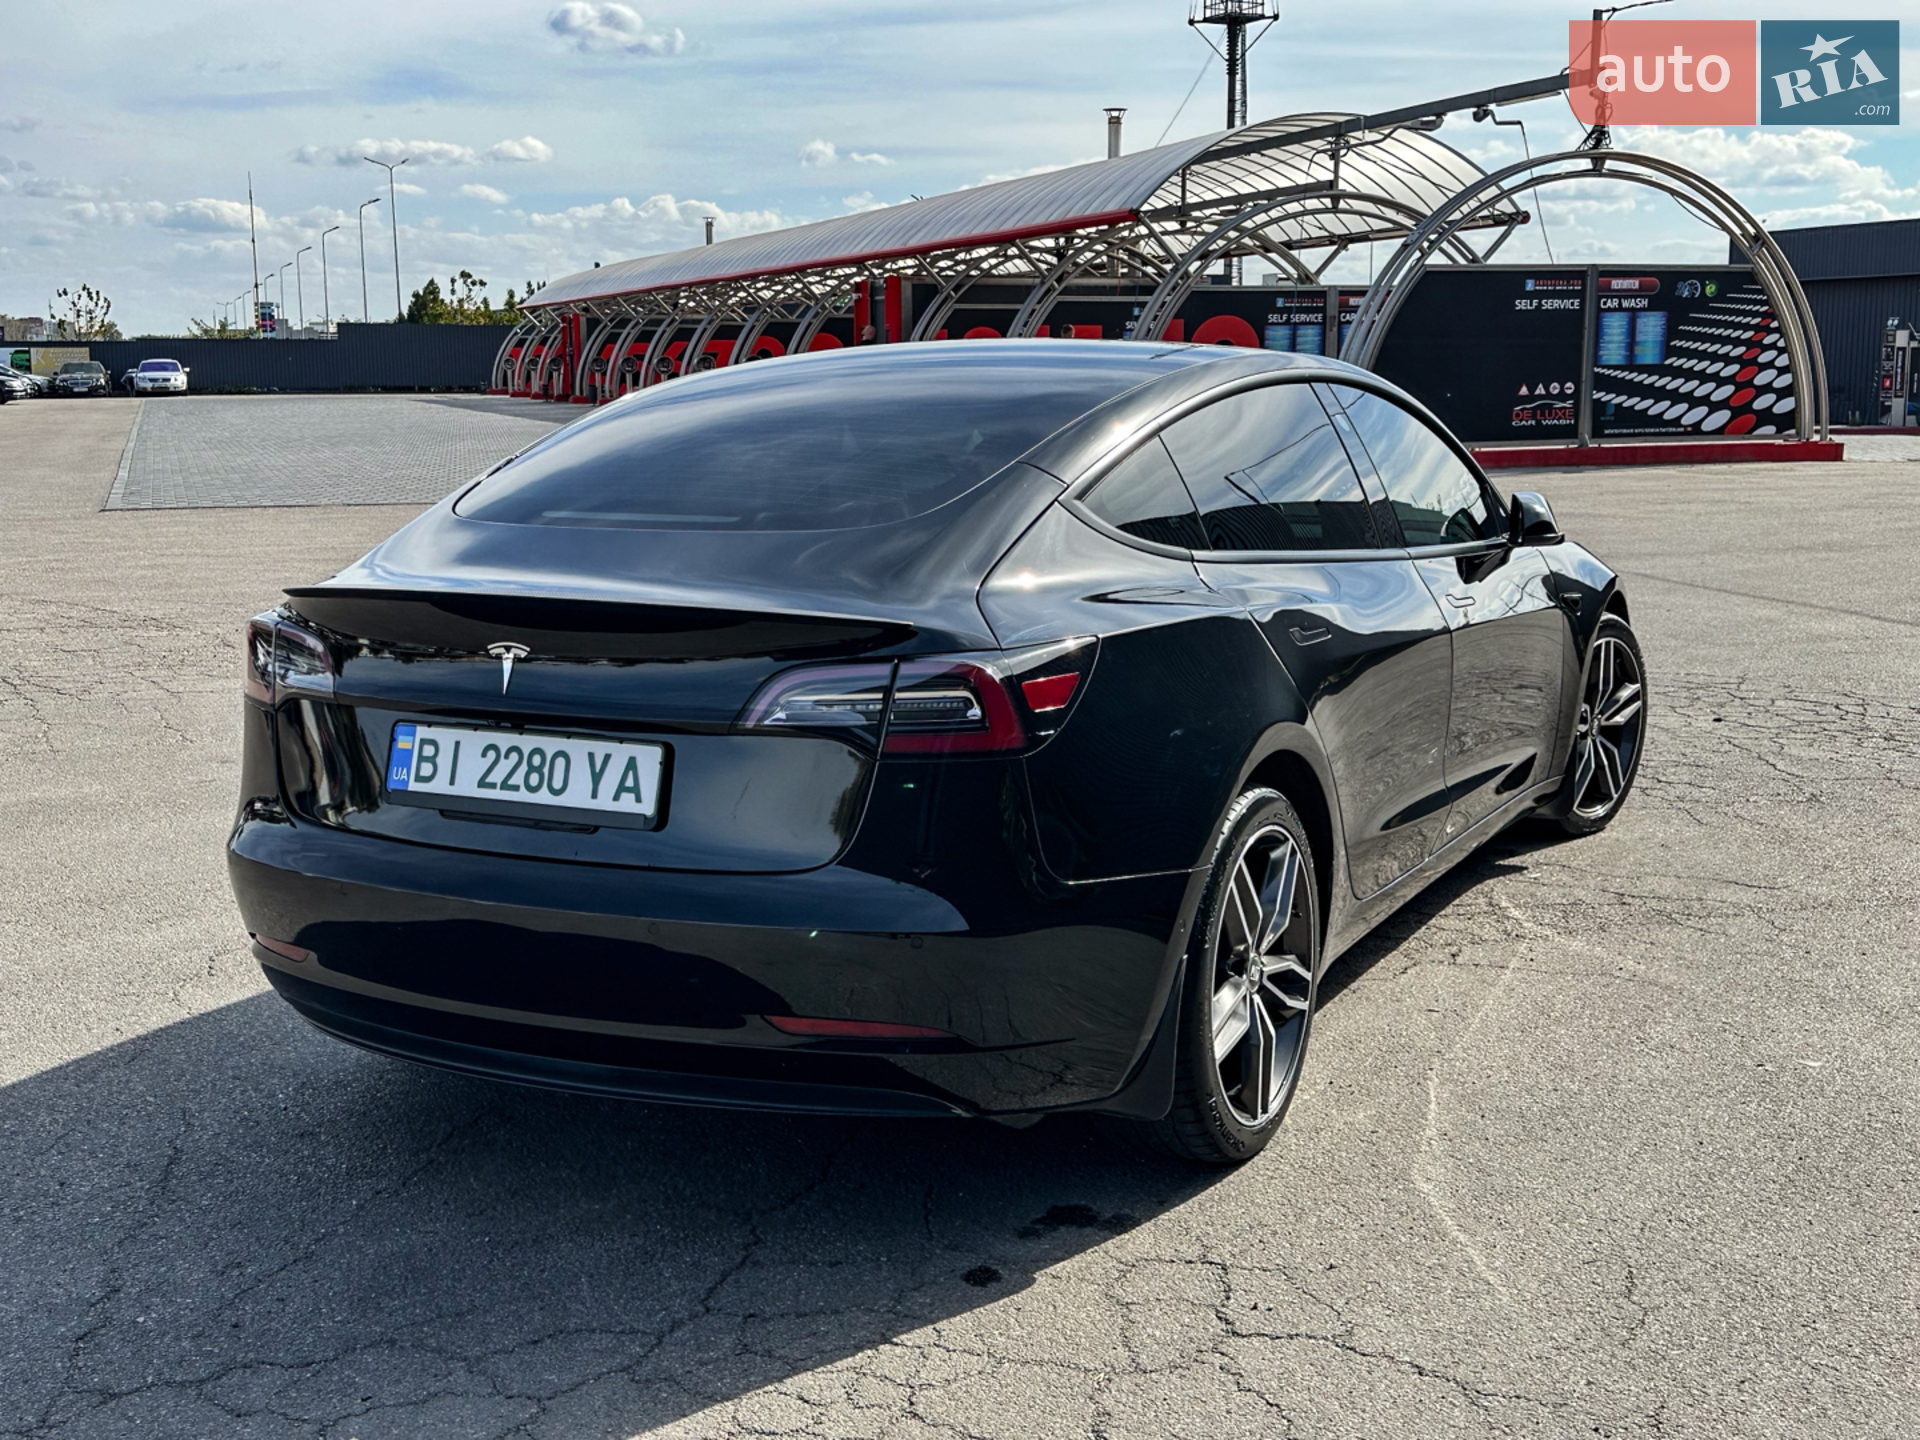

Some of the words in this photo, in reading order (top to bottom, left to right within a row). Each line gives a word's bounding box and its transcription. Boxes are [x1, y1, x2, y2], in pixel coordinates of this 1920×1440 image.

[1515, 299, 1539, 311] SELF
[1541, 299, 1580, 310] SERVICE
[1600, 298, 1620, 309] CAR
[1621, 298, 1649, 309] WASH
[1267, 313, 1288, 323] SELF
[1290, 313, 1323, 322] SERVICE
[1512, 410, 1533, 421] DE
[1536, 408, 1574, 420] LUXE
[392, 766, 408, 781] UA
[414, 738, 461, 787] BI
[477, 743, 571, 797] 2280
[587, 751, 642, 804] YA
